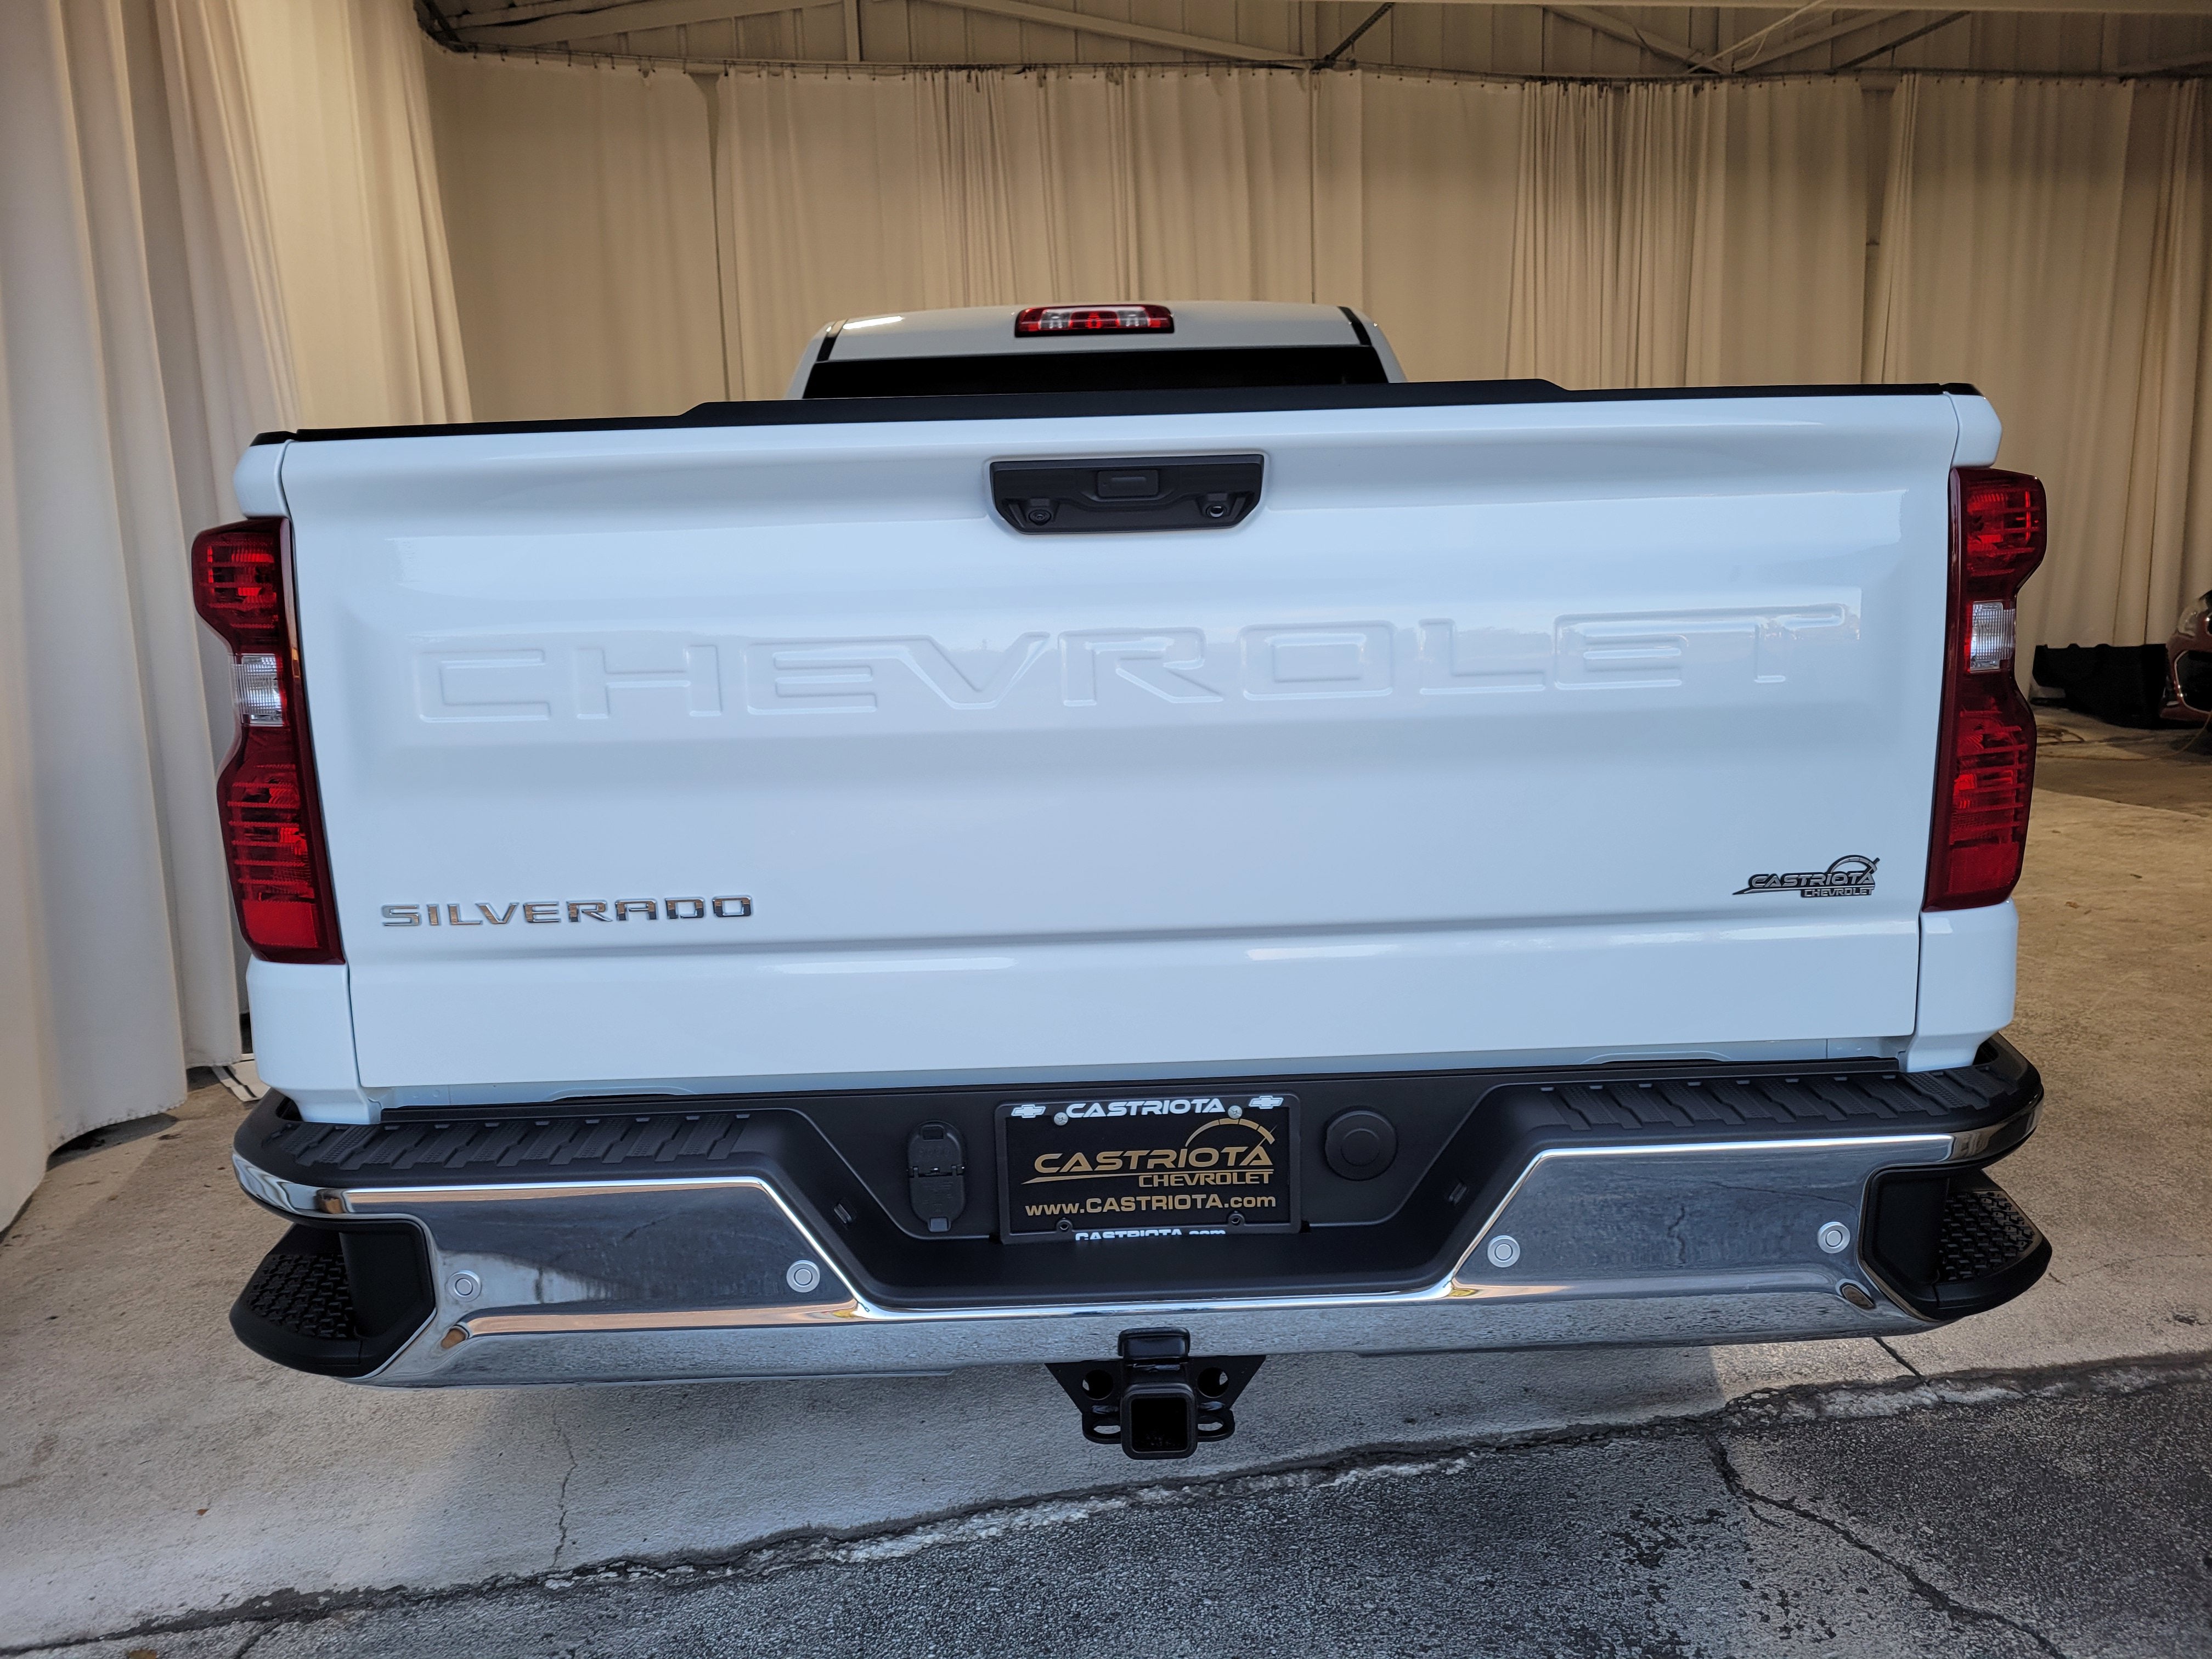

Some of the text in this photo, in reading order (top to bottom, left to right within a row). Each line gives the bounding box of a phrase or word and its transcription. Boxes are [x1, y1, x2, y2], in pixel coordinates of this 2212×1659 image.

[413, 602, 1846, 723] CHEVROLET
[1751, 871, 1875, 887] CASTRIOTA
[1804, 888, 1872, 898] CHEVROLET
[381, 894, 753, 926] SILVERADO
[1065, 1098, 1225, 1118] CASTRIOTA
[1034, 1146, 1273, 1173] CASTRIOTA
[1138, 1172, 1273, 1187] CHEVROLET
[1025, 1194, 1276, 1216] www.CASTRIOTA.com
